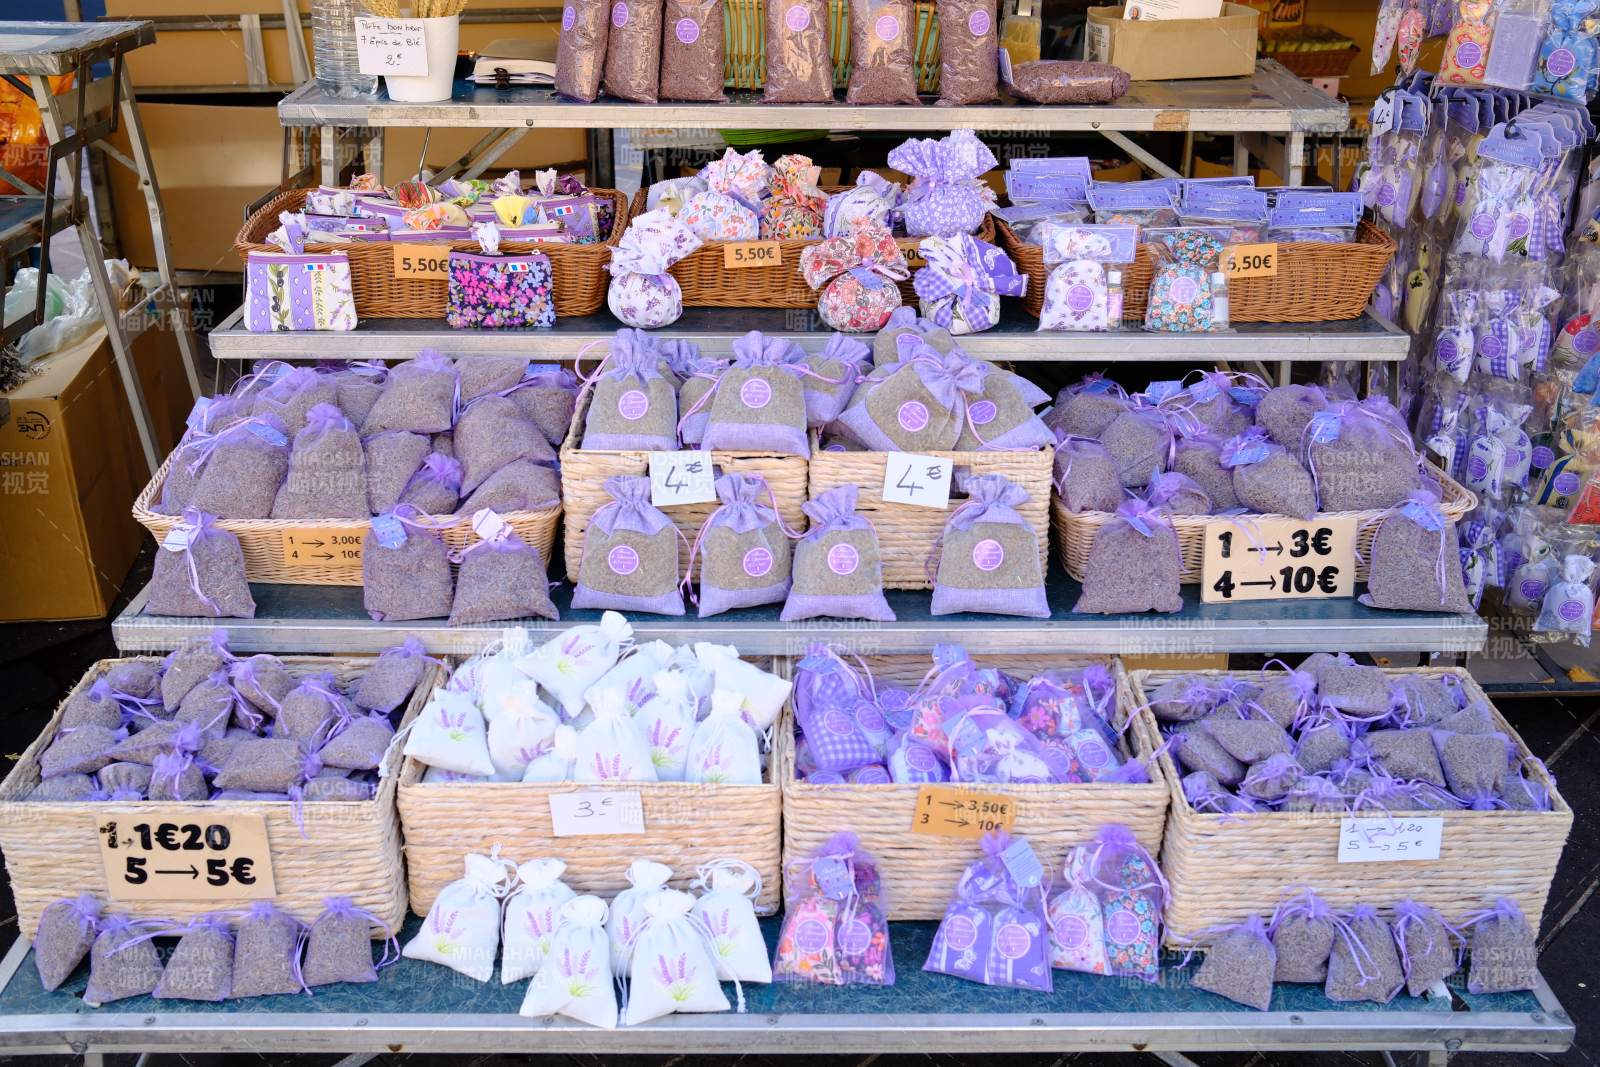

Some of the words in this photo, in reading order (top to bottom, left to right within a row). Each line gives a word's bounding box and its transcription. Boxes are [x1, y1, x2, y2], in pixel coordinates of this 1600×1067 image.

[735, 246, 775, 262] 5,50€
[402, 257, 449, 273] 5,50€
[289, 536, 294, 545] 1
[331, 536, 362, 546] 3,00€
[1218, 531, 1233, 558] 1
[1290, 527, 1333, 558] 3€
[291, 550, 299, 559] 4
[341, 550, 361, 559] 10€
[1213, 570, 1236, 598] 4
[1279, 566, 1340, 593] 10€
[926, 795, 932, 806] 1
[968, 800, 1008, 815] 3,50€
[920, 813, 930, 824] 3
[133, 823, 231, 851] 1€20
[1346, 840, 1360, 850] 5
[124, 856, 148, 884] 5
[206, 857, 256, 886] 5€
